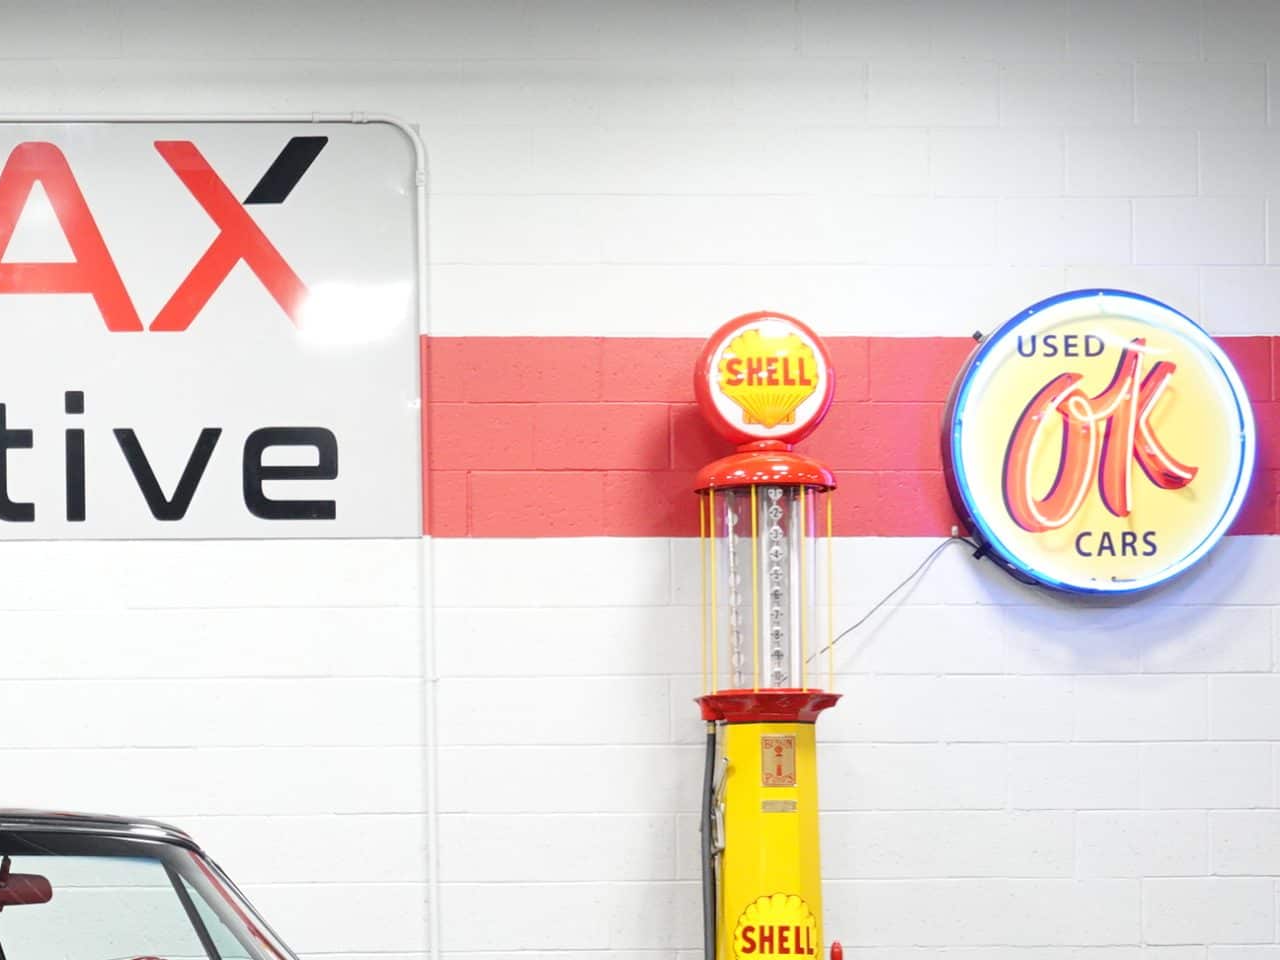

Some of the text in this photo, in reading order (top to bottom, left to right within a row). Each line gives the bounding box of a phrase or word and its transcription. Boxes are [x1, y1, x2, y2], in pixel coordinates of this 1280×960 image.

[1017, 334, 1105, 358] USED
[726, 357, 812, 386] SHELL
[1001, 337, 1199, 533] OK
[1075, 530, 1158, 557] CARS
[741, 925, 815, 955] SHELL
